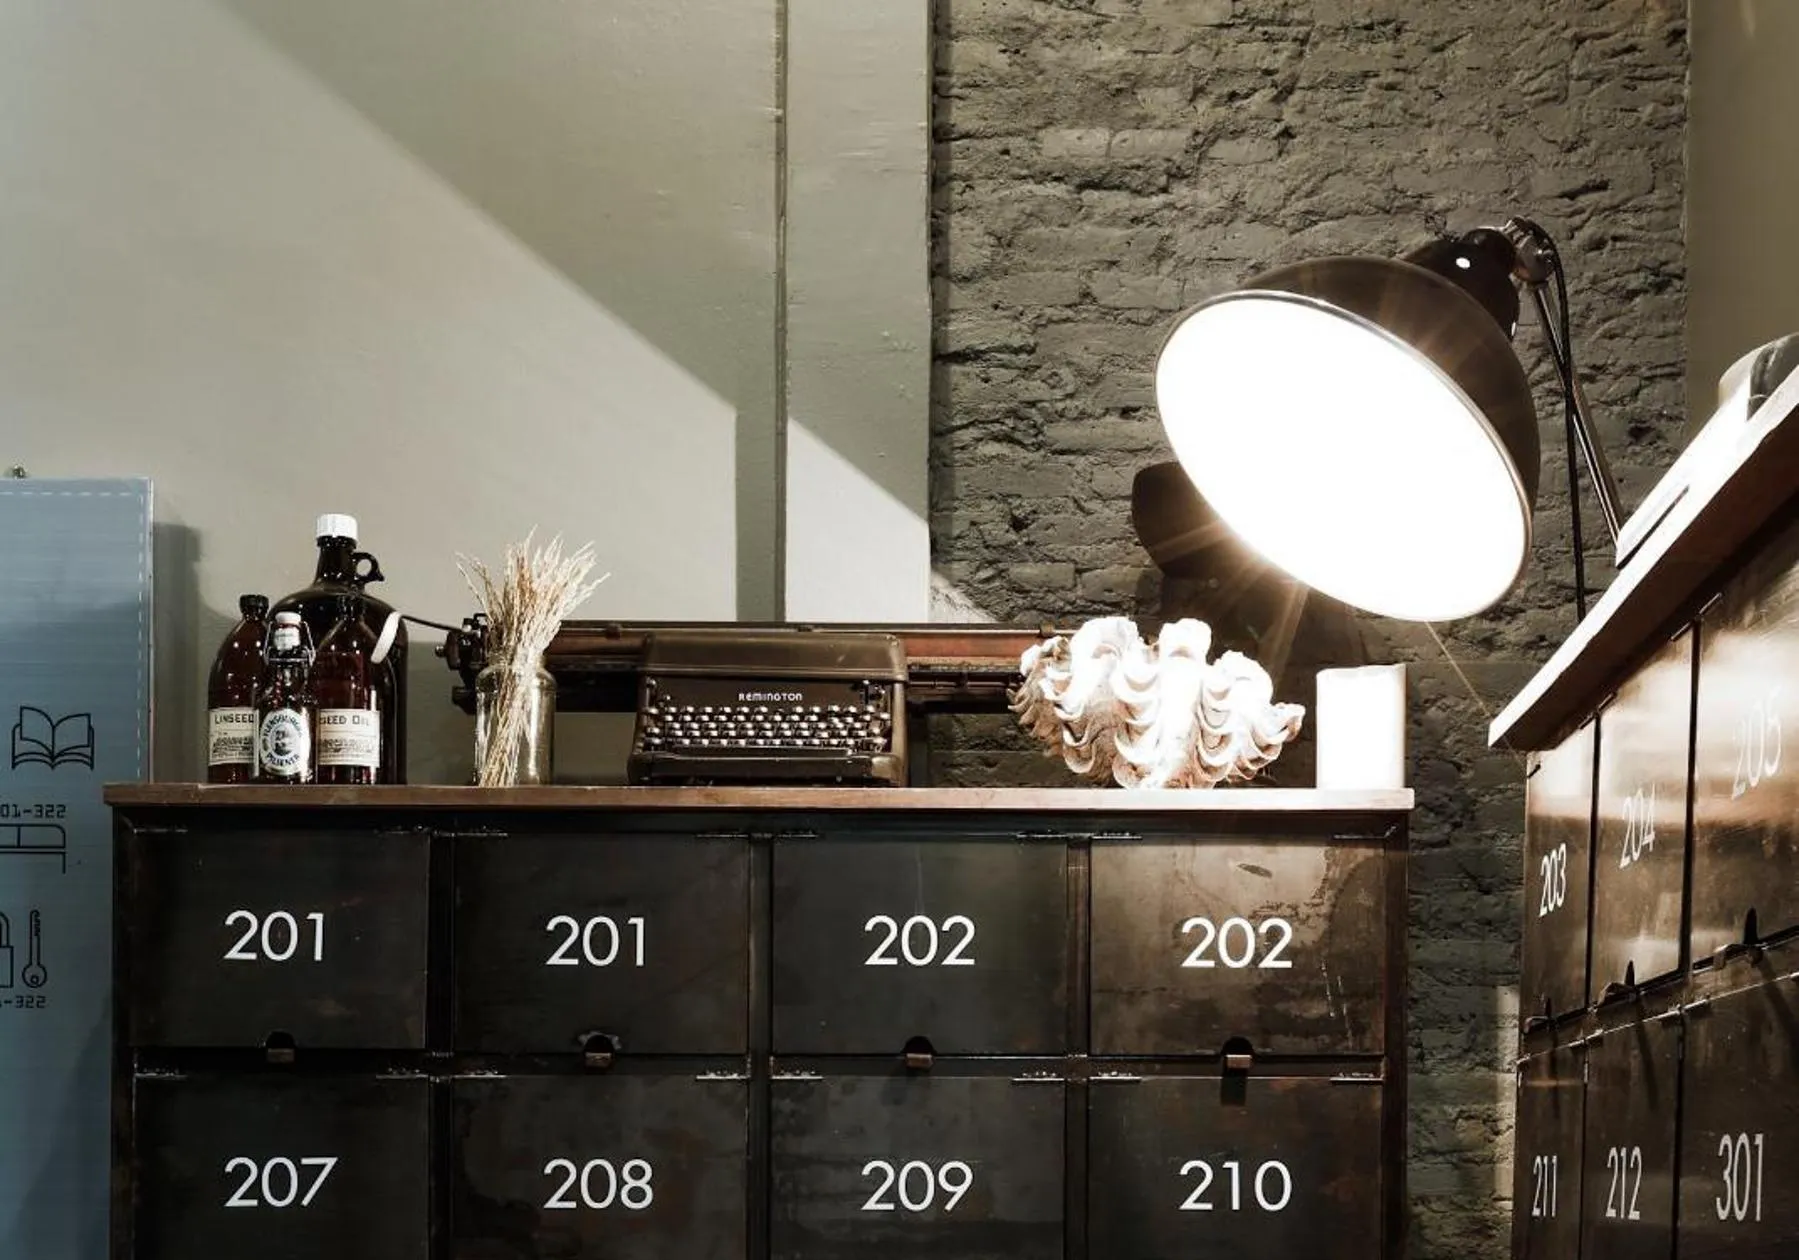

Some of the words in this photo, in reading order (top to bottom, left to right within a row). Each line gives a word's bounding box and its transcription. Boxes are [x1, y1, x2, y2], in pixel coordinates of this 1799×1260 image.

[214, 713, 254, 725] LINSEED
[1731, 687, 1782, 800] 205
[1619, 782, 1656, 870] 204
[1539, 842, 1567, 918] 203
[223, 910, 324, 962] 201
[545, 915, 645, 967] 201
[864, 914, 976, 967] 202
[1181, 916, 1293, 969] 202
[0, 995, 46, 1009] -322
[224, 1156, 338, 1207] 207
[543, 1158, 654, 1210] 208
[860, 1160, 974, 1212] 209
[1179, 1159, 1292, 1212] 210
[1532, 1155, 1557, 1218] 211
[1605, 1146, 1642, 1220] 212
[1715, 1132, 1764, 1222] 301
